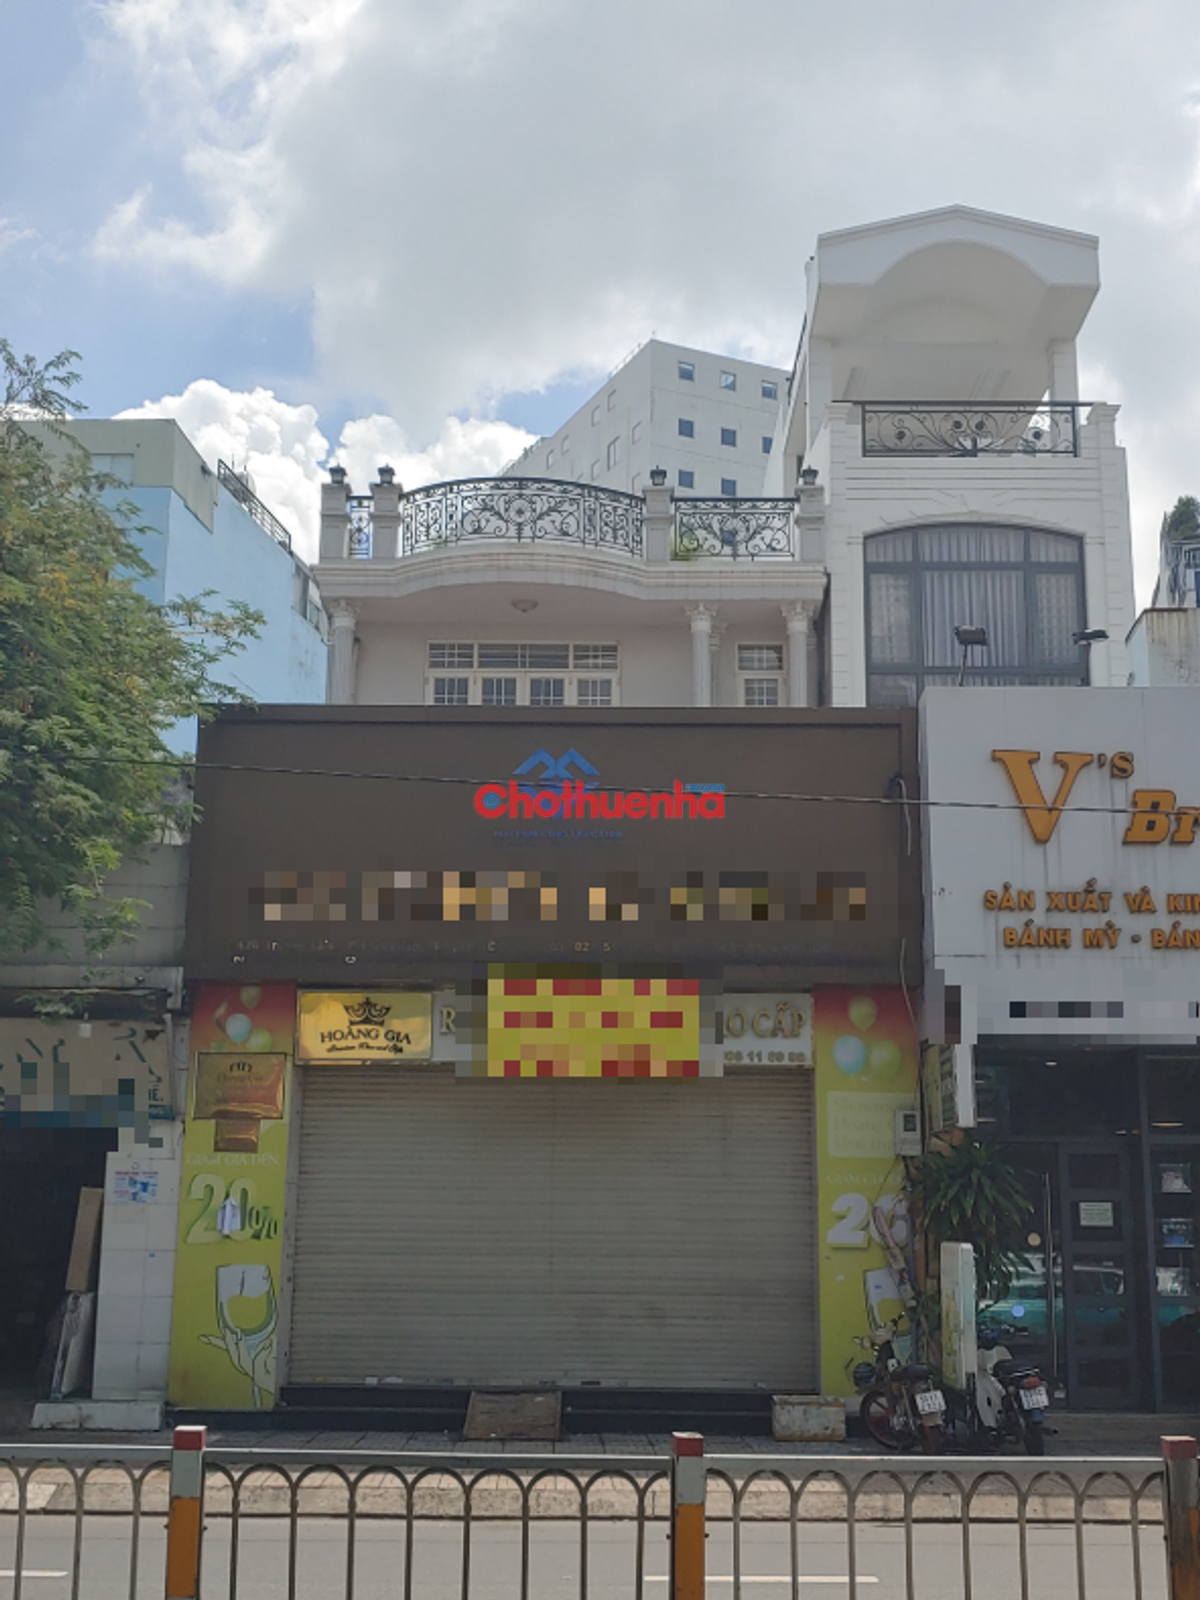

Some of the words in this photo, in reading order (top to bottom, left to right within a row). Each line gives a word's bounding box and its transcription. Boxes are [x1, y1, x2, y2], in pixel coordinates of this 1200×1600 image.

[991, 749, 1134, 845] V's
[983, 881, 1036, 911] SẢN
[1046, 877, 1112, 913] XUẤT
[1125, 885, 1157, 914] VÀ
[1003, 918, 1071, 948] BÁNH
[320, 1026, 380, 1044] HOÀNG
[383, 1029, 411, 1045] GIA
[752, 1001, 807, 1038] CẤP
